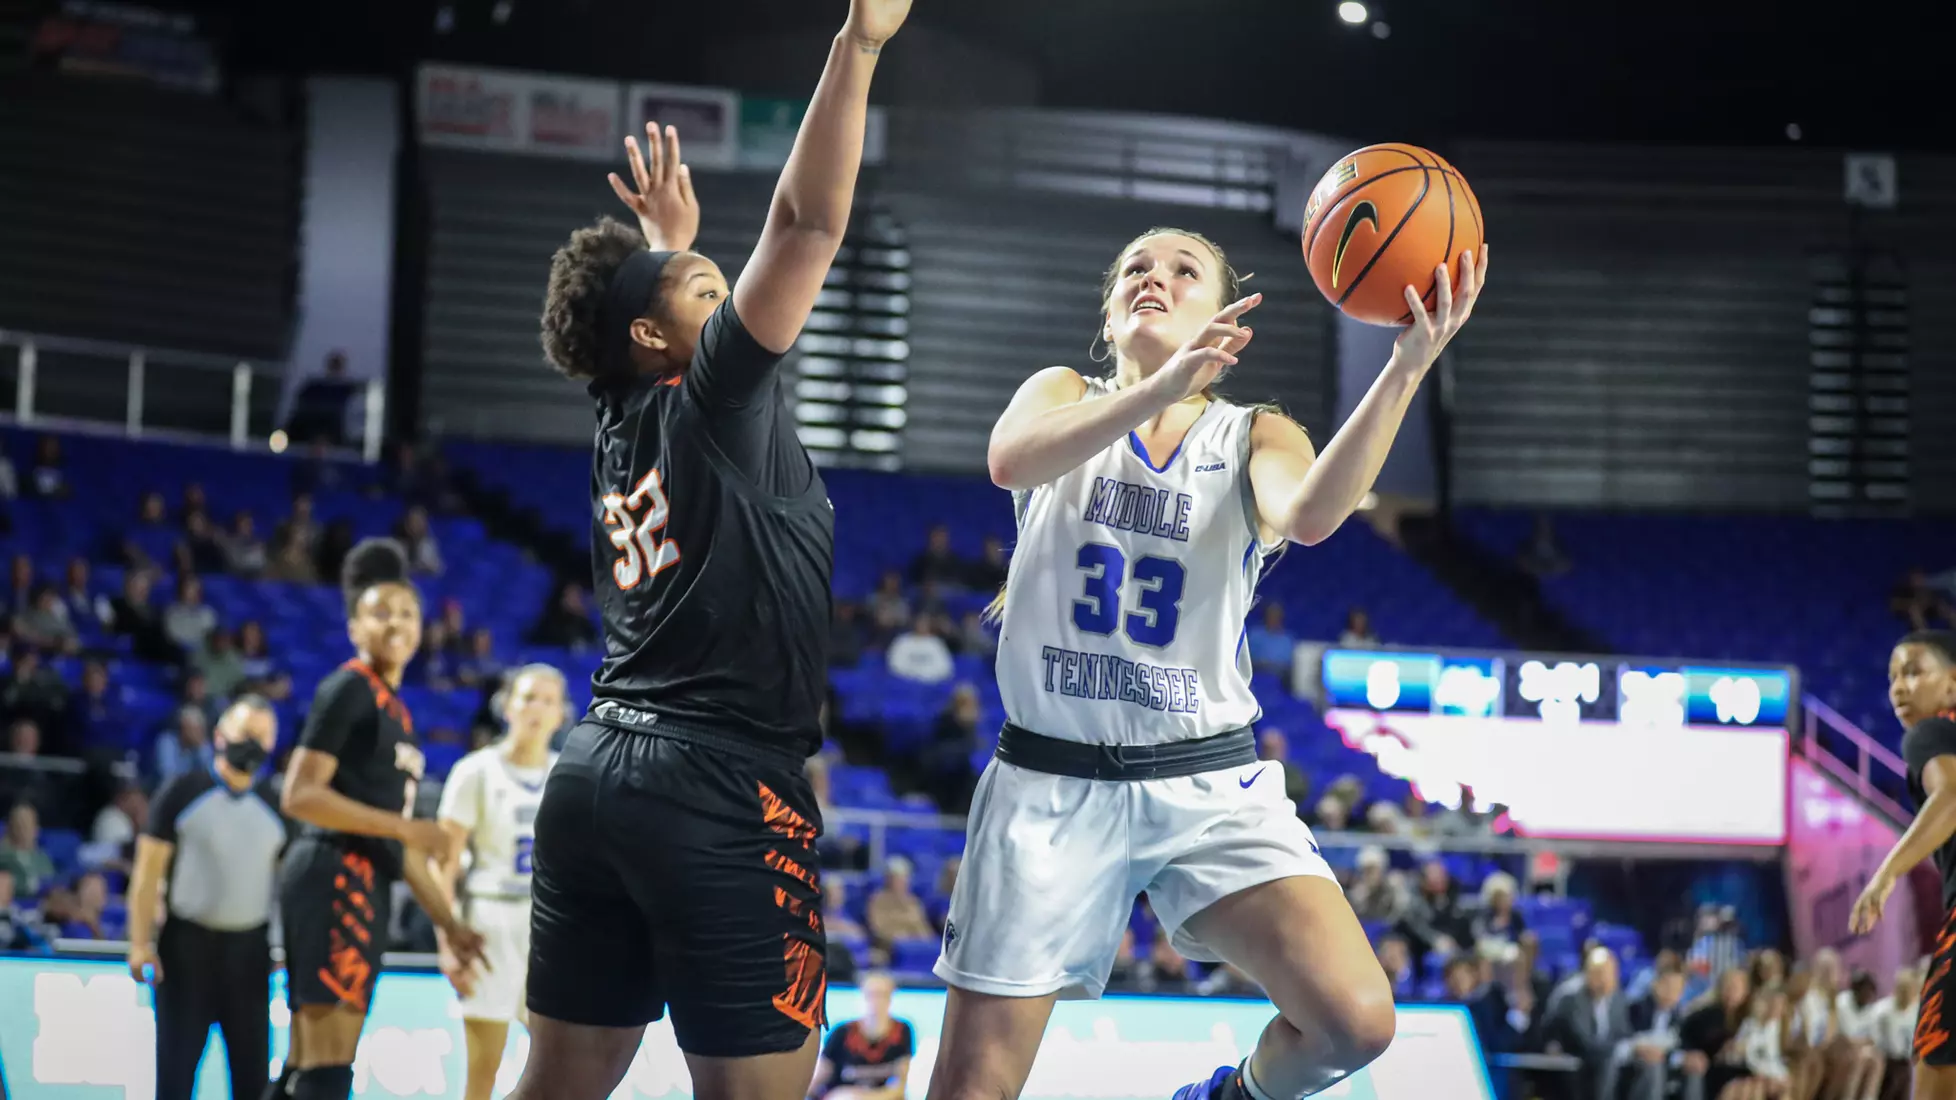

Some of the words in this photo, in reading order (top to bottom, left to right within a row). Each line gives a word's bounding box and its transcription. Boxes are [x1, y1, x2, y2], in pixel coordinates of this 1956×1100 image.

[602, 468, 681, 590] 32
[1084, 476, 1193, 542] MIDDLE
[1070, 541, 1188, 650] 33
[1042, 645, 1200, 713] TENNESSEE
